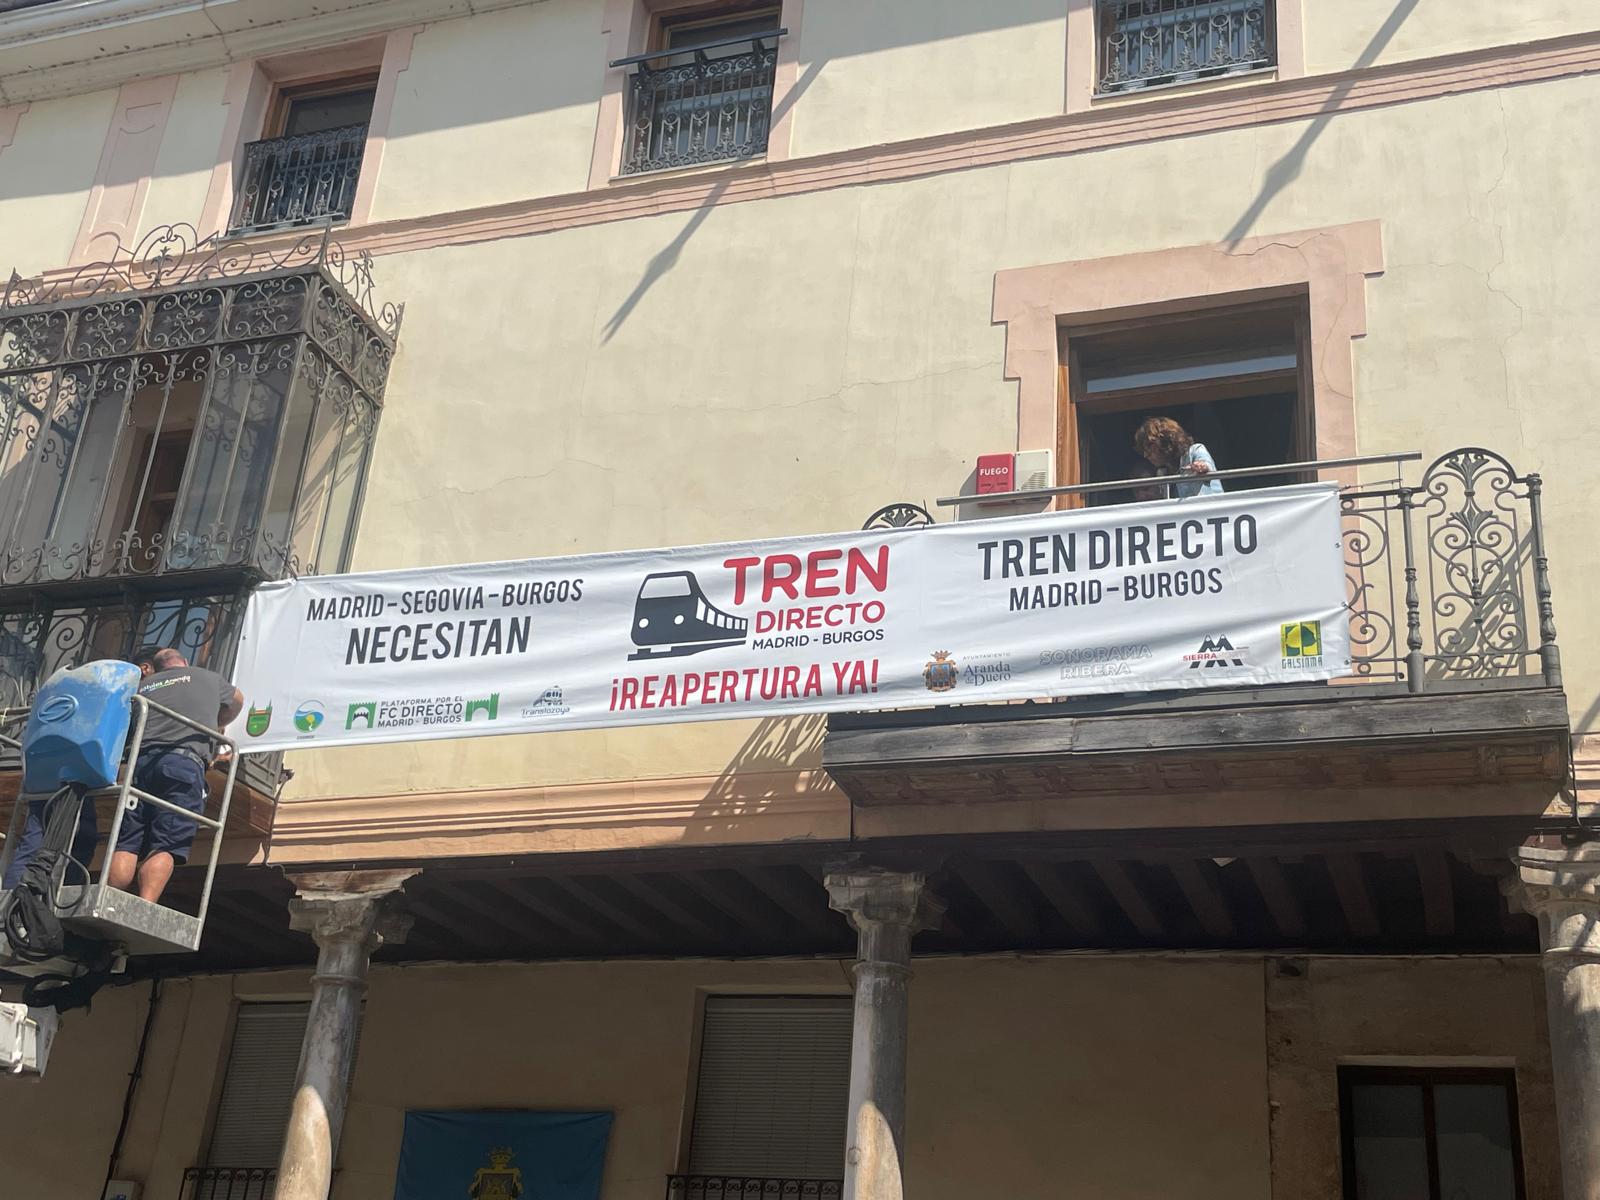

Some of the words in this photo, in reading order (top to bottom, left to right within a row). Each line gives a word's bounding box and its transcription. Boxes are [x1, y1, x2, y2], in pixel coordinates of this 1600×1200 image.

[980, 467, 1008, 476] FUEGO
[977, 532, 1076, 581] TREN
[1089, 513, 1258, 571] DIRECTO
[723, 545, 889, 606] TREN
[755, 600, 885, 633] DIRECTO
[345, 615, 532, 665] NECESITAN
[752, 635, 809, 650] MADRID
[822, 629, 884, 646] BURGOS
[1039, 643, 1153, 666] SONORAMA
[1183, 653, 1217, 662] SIERRA
[832, 659, 880, 696] YA!
[963, 661, 1011, 676] Aranda
[1060, 662, 1132, 680] RIBERA
[974, 671, 1011, 687] Duero
[381, 698, 432, 707] PLATAFORMA
[435, 696, 451, 704] POR
[379, 707, 399, 719] FC
[401, 703, 462, 717] DIRECTO
[377, 718, 414, 728] MADRID
[423, 715, 462, 725] BURGOS
